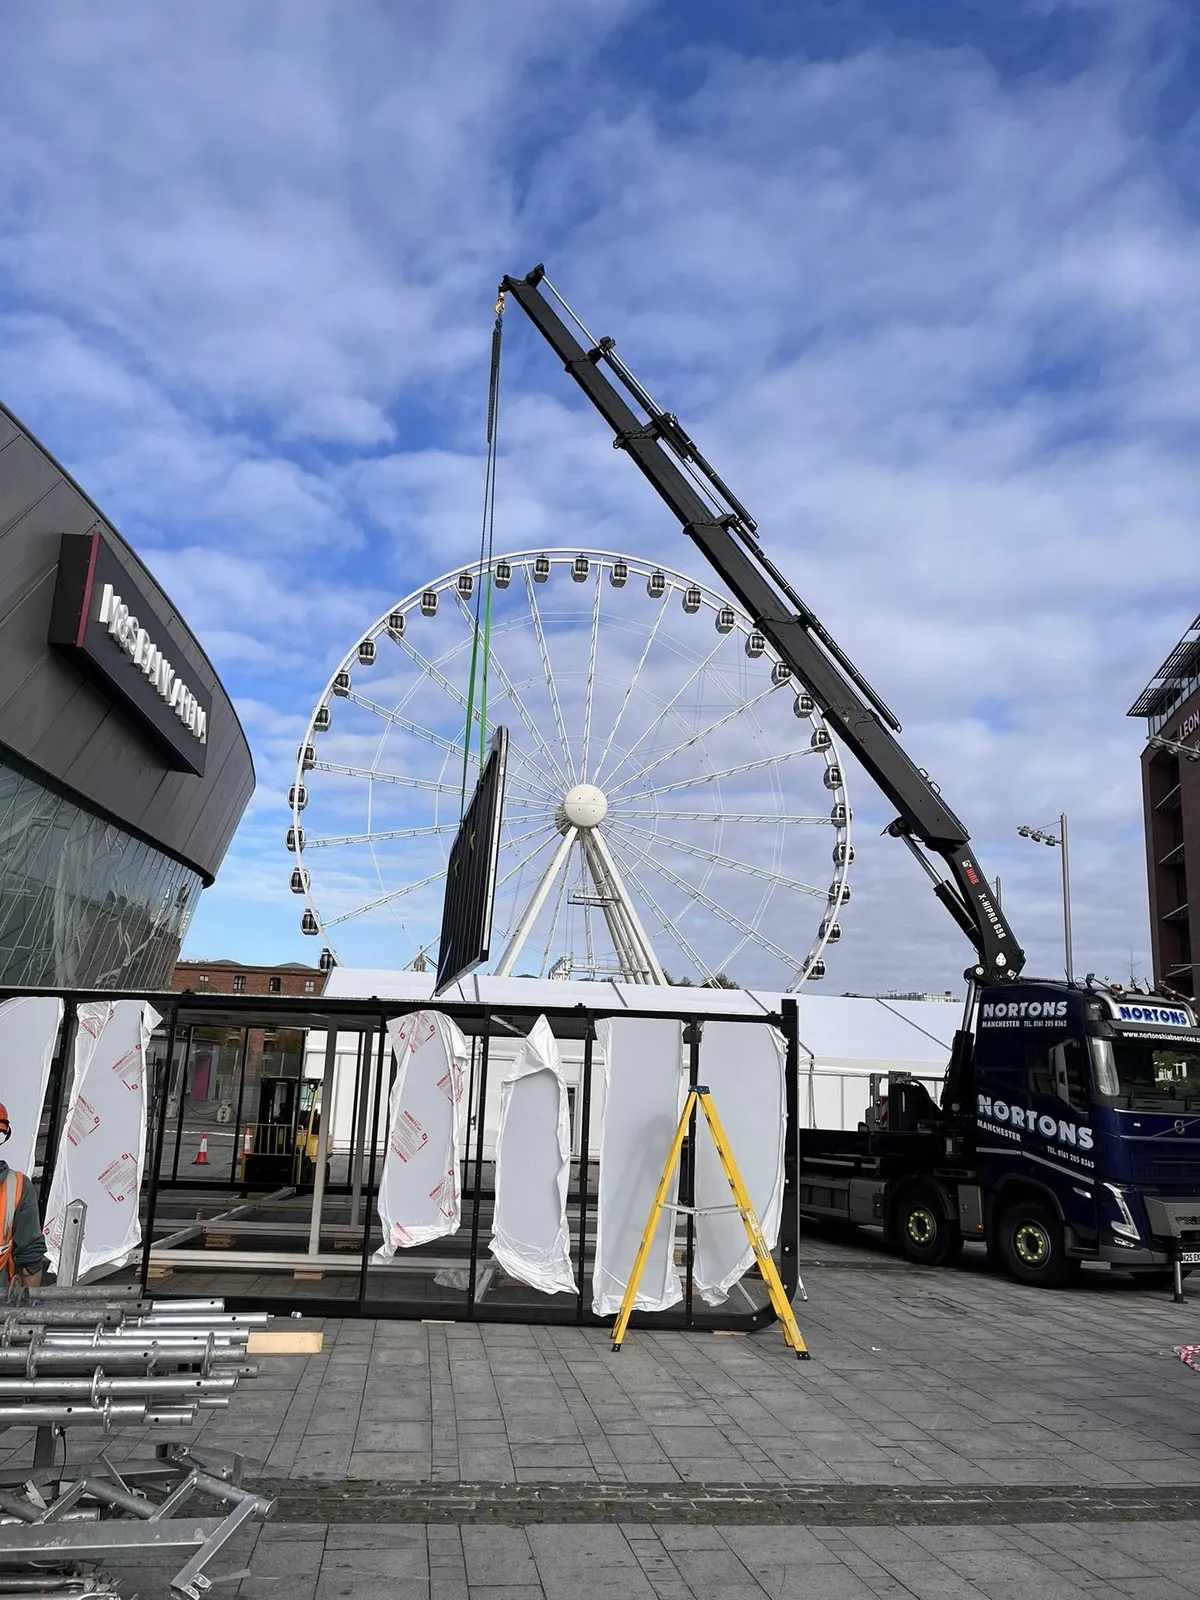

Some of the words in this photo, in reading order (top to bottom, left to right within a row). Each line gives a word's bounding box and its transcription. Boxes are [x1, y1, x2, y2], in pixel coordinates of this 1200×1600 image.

[966, 868, 980, 885] HIAB
[983, 1001, 1068, 1018] NORTONS
[1119, 1006, 1188, 1025] NORTONS
[982, 1020, 1020, 1028] MANCHESTER
[977, 1094, 1094, 1150] NORTONS
[977, 1119, 1022, 1142] MANCHESTER
